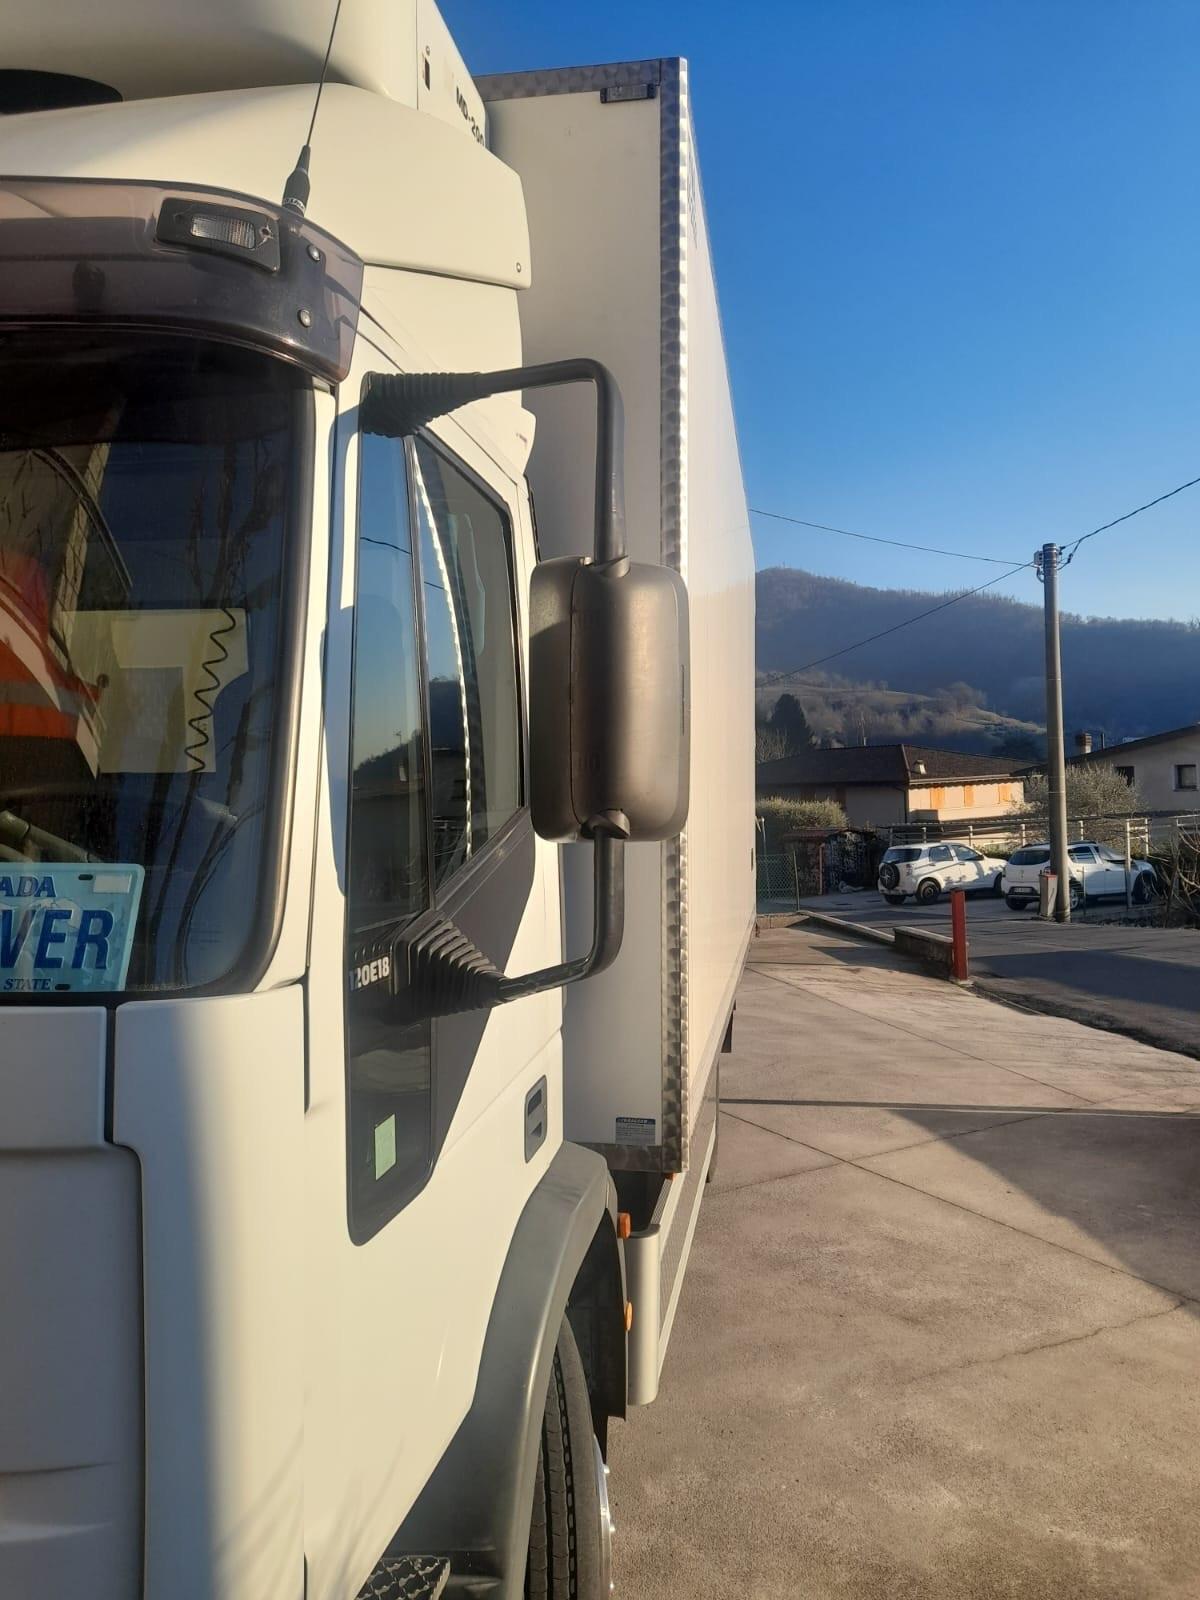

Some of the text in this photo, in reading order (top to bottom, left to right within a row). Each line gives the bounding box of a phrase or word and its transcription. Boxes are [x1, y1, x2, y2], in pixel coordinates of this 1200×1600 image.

[0, 876, 56, 897] ADA
[0, 908, 114, 969] VER
[4, 978, 52, 990] STATE
[349, 956, 390, 992] 120E18
